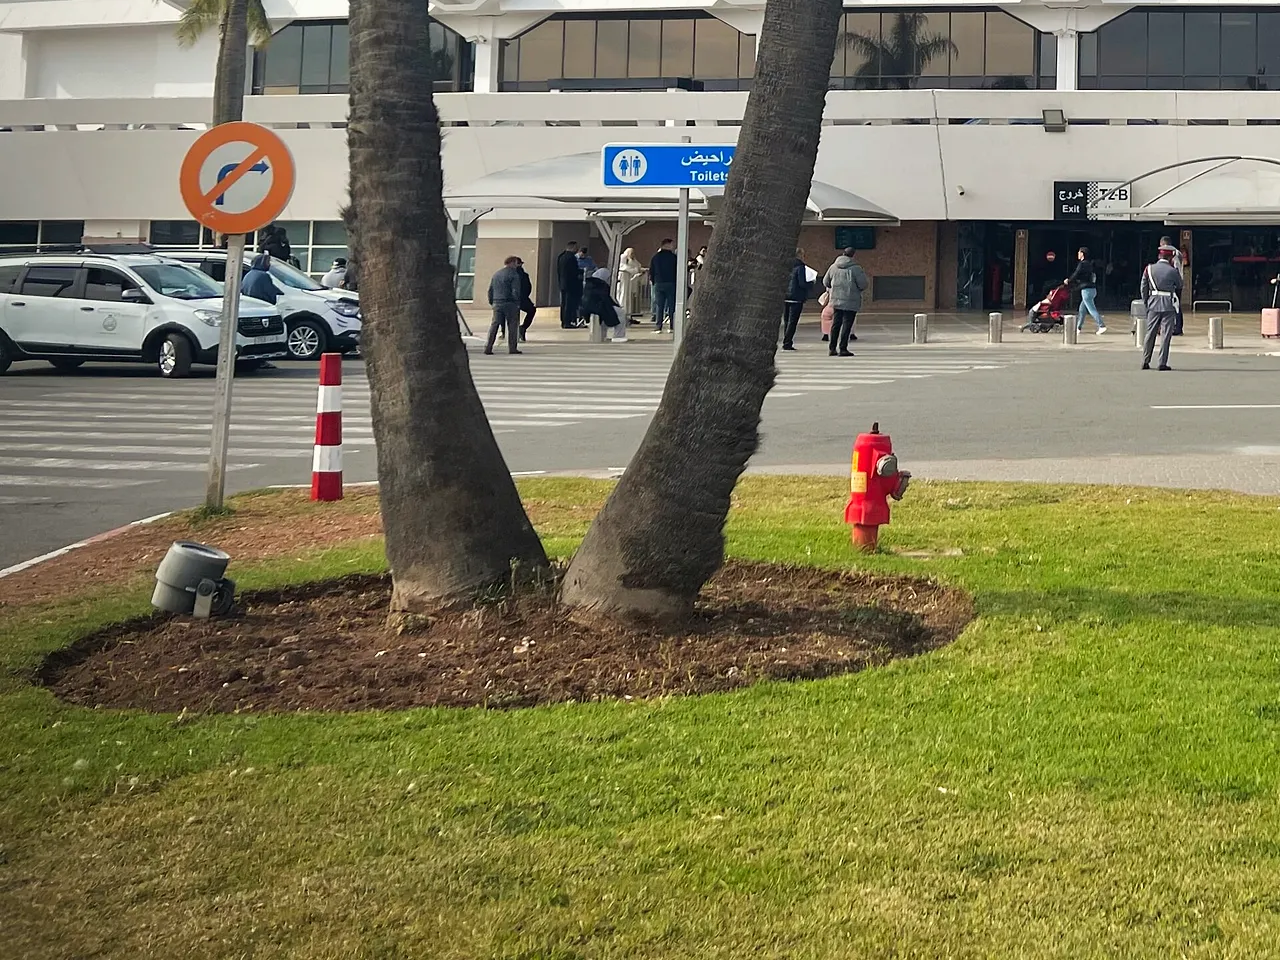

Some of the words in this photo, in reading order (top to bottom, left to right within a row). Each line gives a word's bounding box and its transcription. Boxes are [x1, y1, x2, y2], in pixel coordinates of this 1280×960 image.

[681, 150, 733, 166] راحيض
[1058, 188, 1084, 201] خروج
[1062, 204, 1081, 213] Exit
